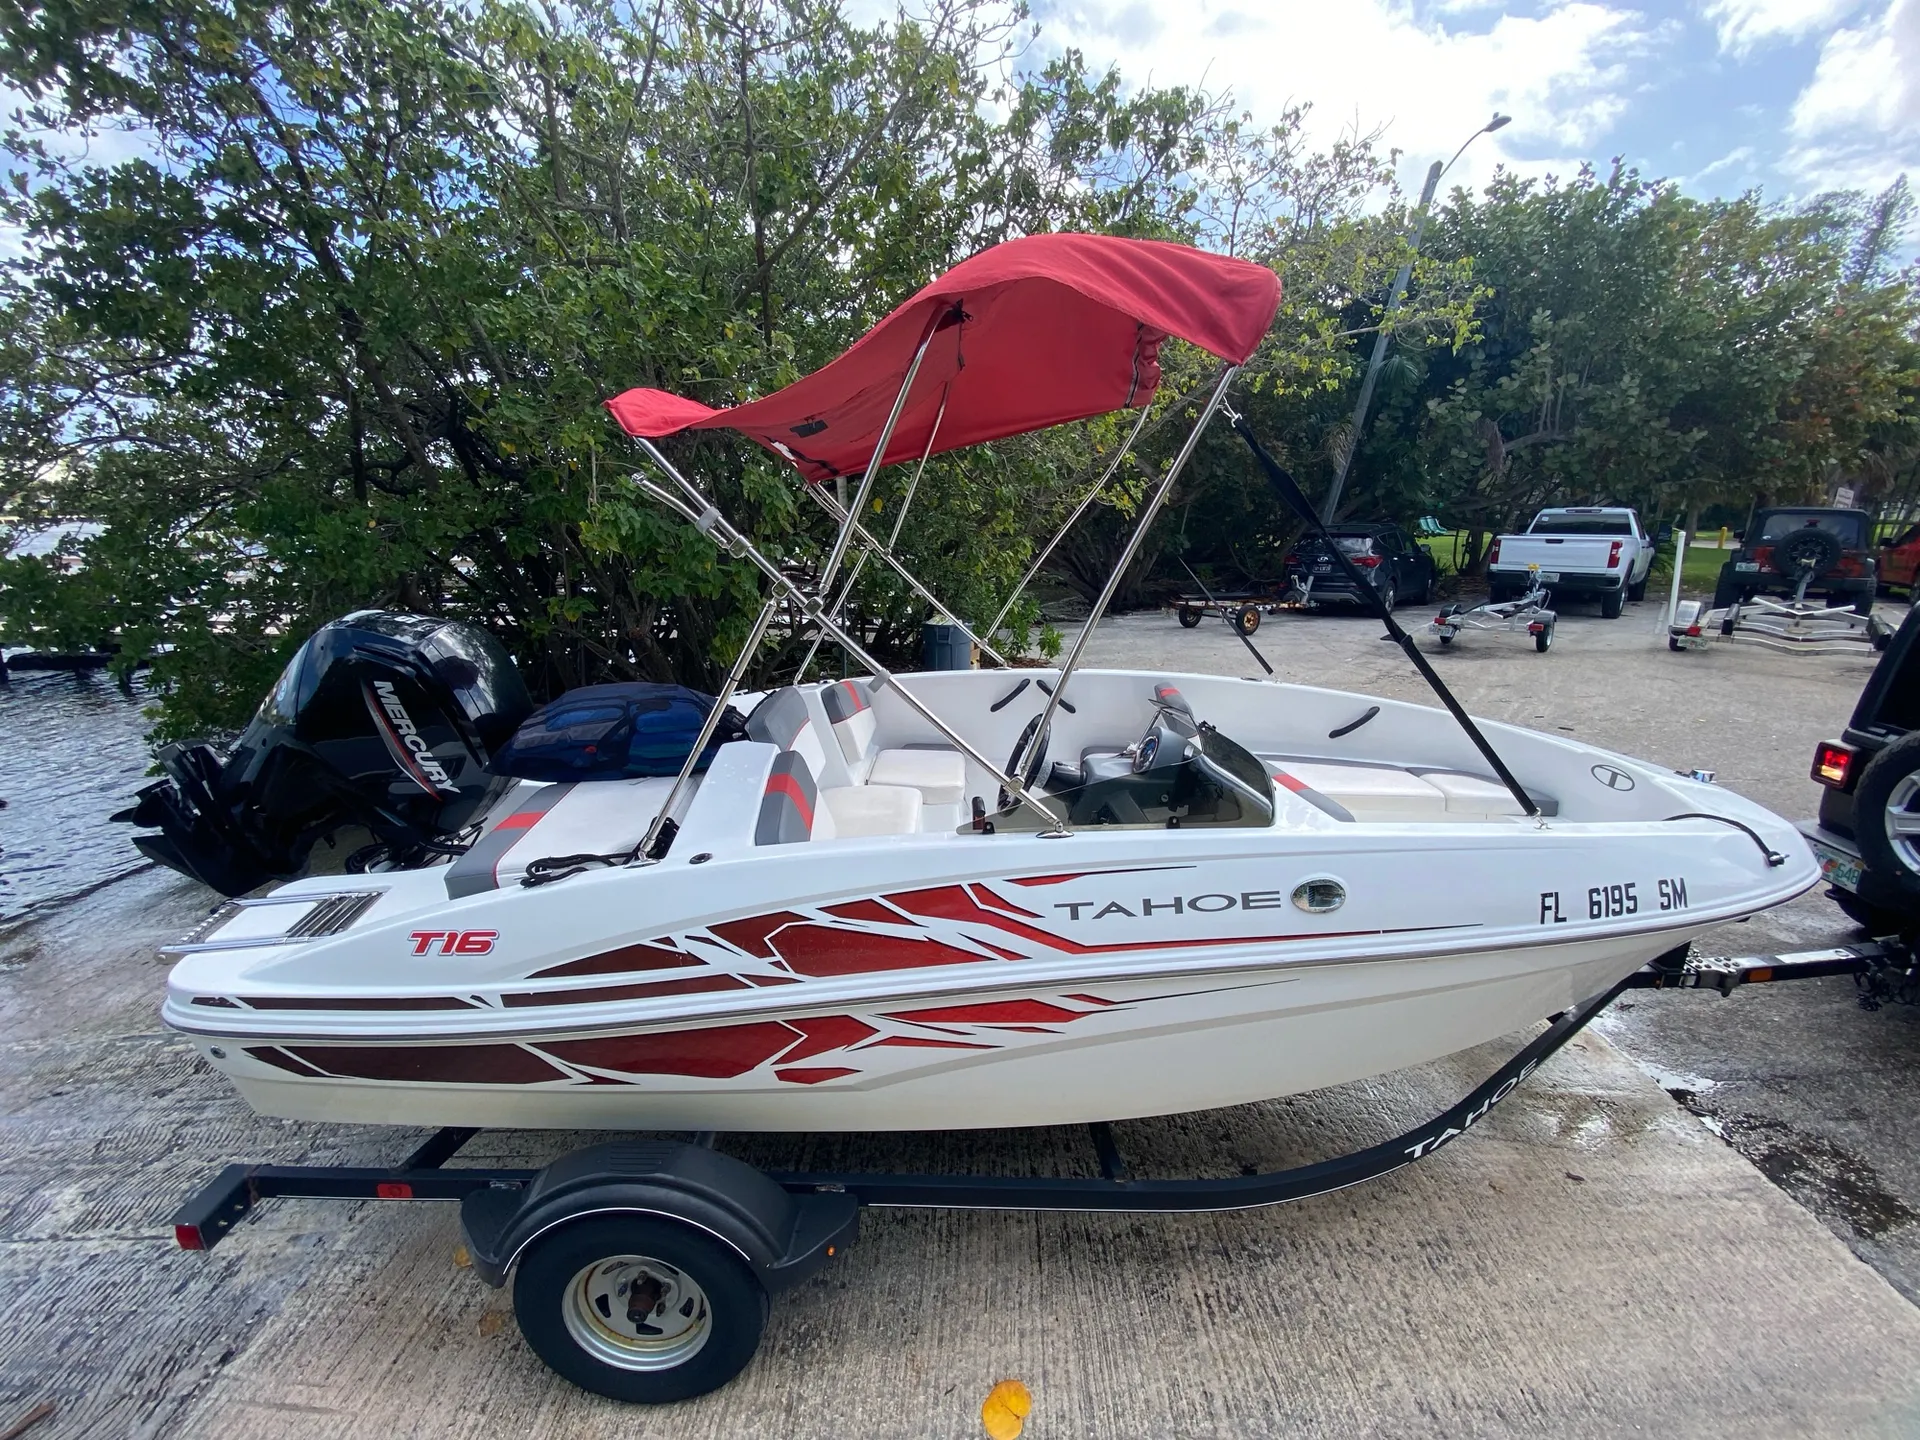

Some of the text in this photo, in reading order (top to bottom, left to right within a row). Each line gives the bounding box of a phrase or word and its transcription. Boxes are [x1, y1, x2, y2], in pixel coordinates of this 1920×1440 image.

[373, 680, 461, 793] MERCURY
[1053, 890, 1282, 920] TAHOE
[1540, 877, 1688, 924] FL 6195 SM
[407, 929, 500, 956] T16
[1404, 1057, 1538, 1159] TAHOE
